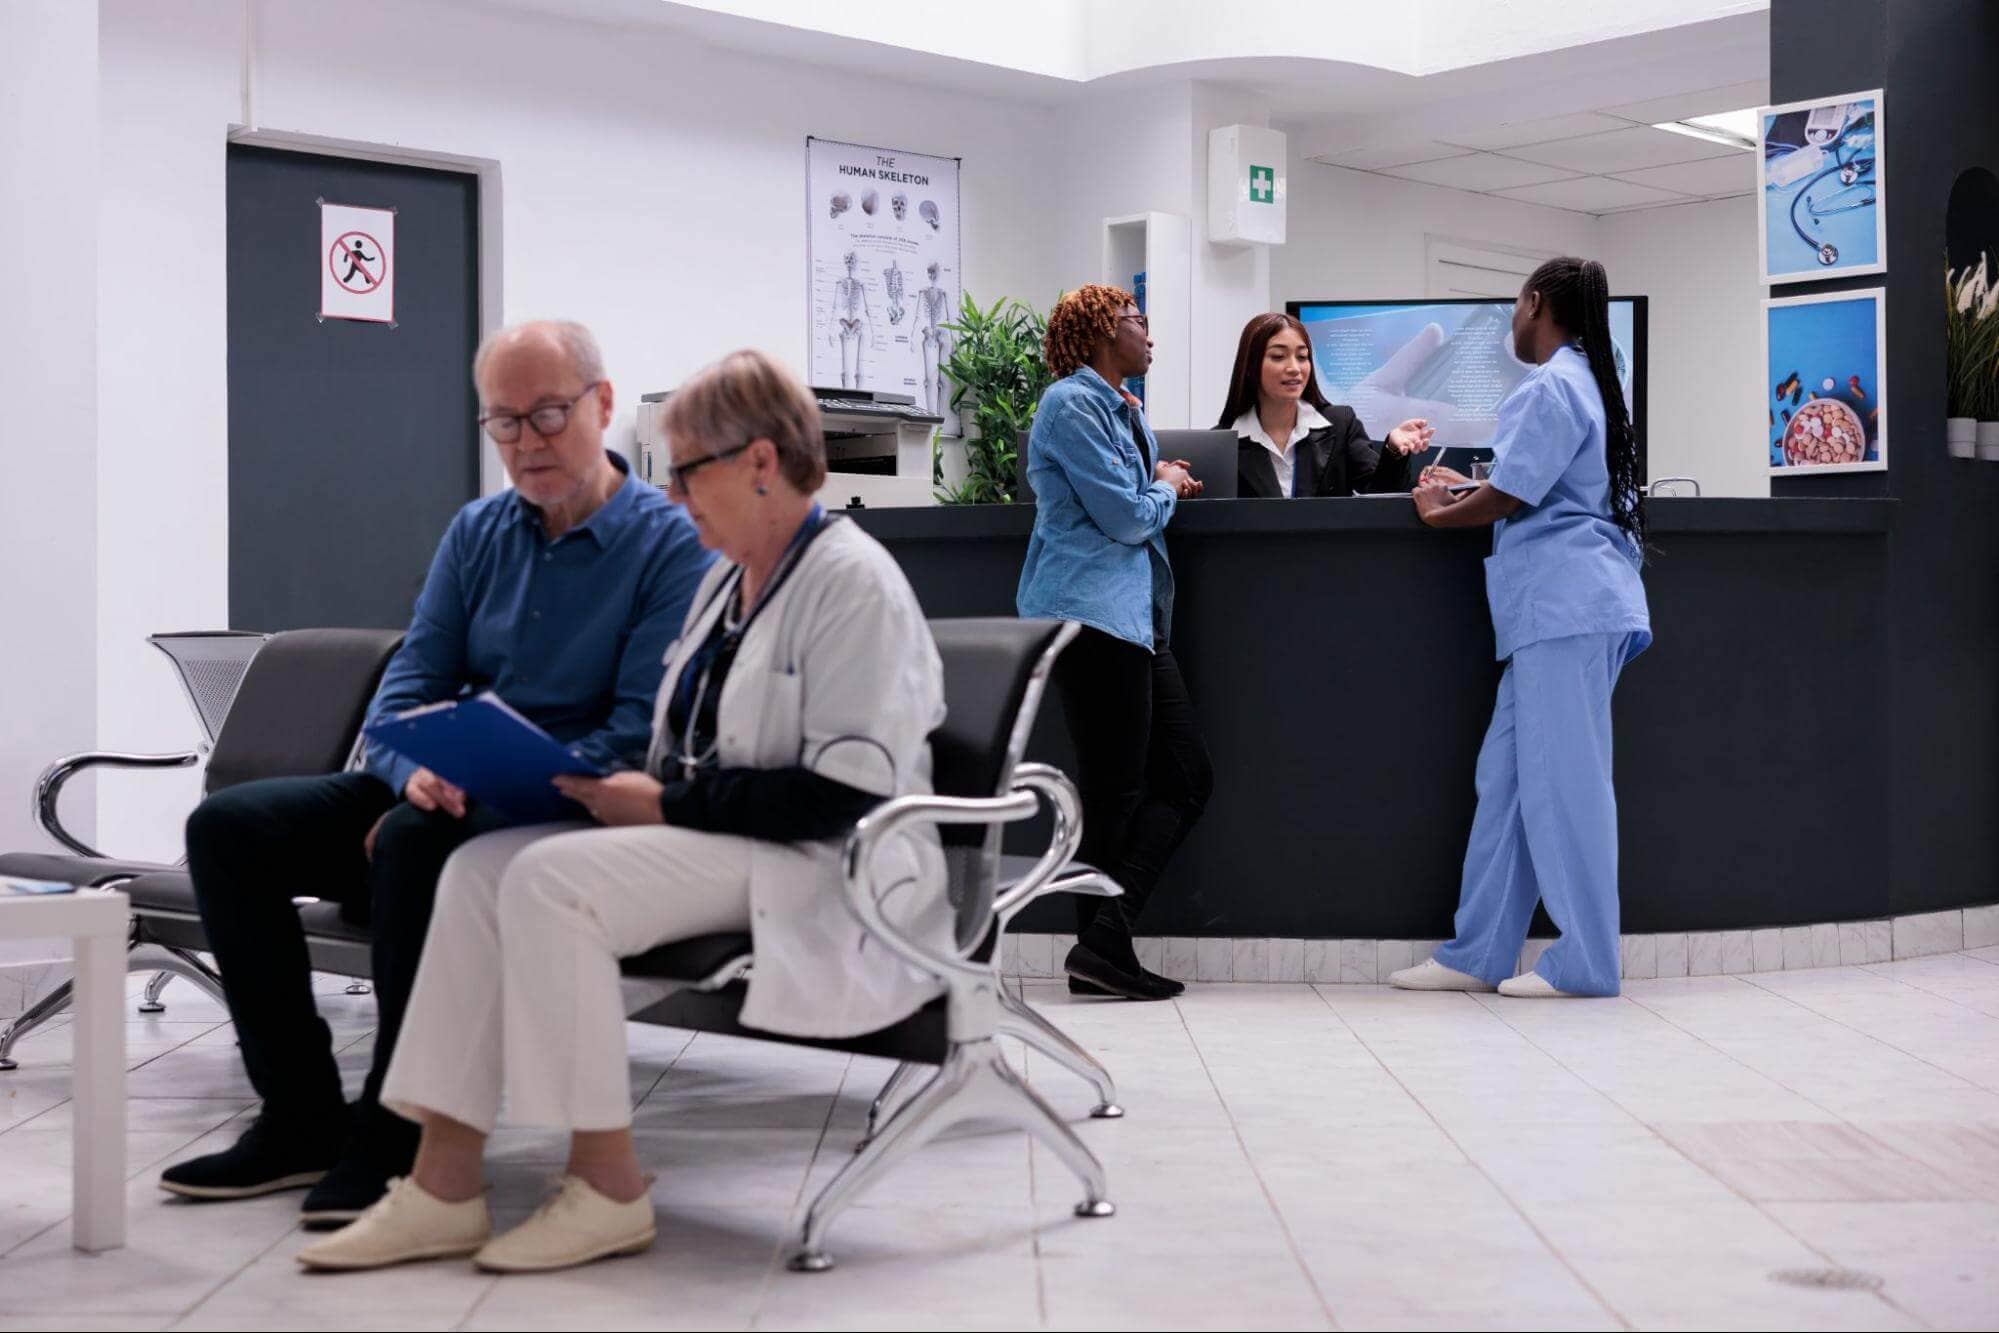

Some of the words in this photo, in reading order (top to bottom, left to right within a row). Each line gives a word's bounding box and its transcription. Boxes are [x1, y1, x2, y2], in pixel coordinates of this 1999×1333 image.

[876, 156, 896, 168] THE
[839, 165, 876, 179] HUMAN
[878, 170, 929, 186] SKELETON
